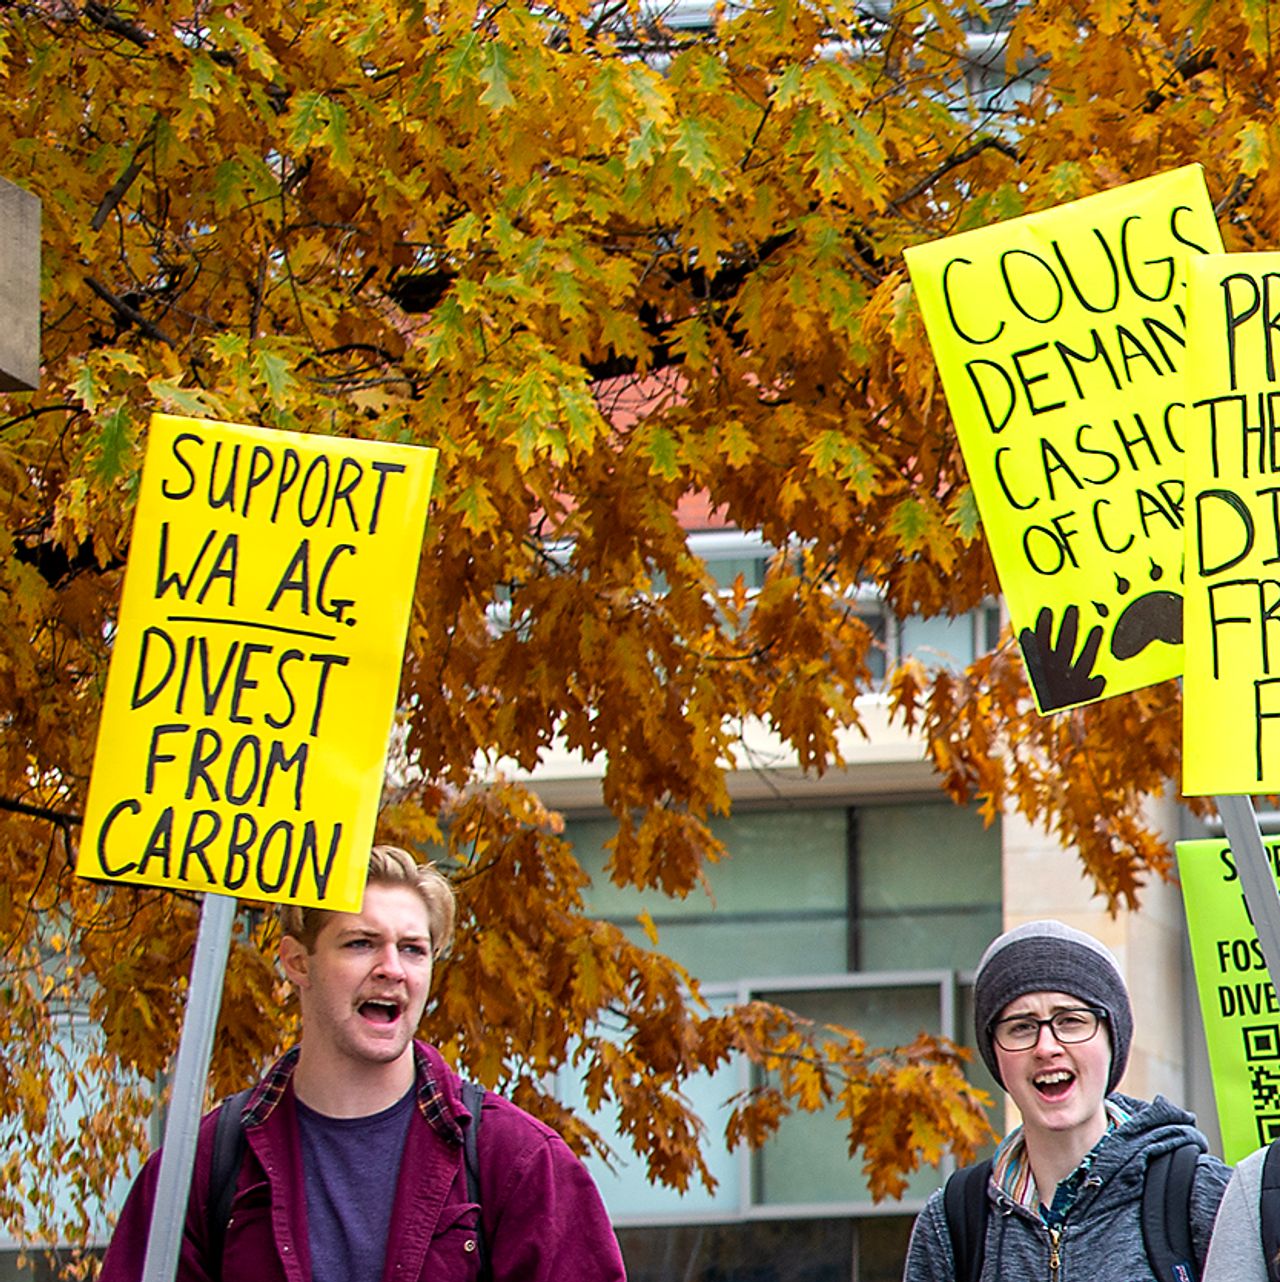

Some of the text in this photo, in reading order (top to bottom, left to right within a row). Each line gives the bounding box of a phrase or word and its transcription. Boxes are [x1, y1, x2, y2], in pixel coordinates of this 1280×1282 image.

[943, 206, 1211, 345] COUGS
[966, 304, 1187, 434] DEMAN
[162, 433, 405, 535] SUPPORT
[1022, 480, 1186, 576] OF CAR
[154, 522, 238, 605] WA
[131, 626, 350, 737] DIVEST
[145, 724, 308, 811] FROM
[97, 798, 342, 901] CARBON
